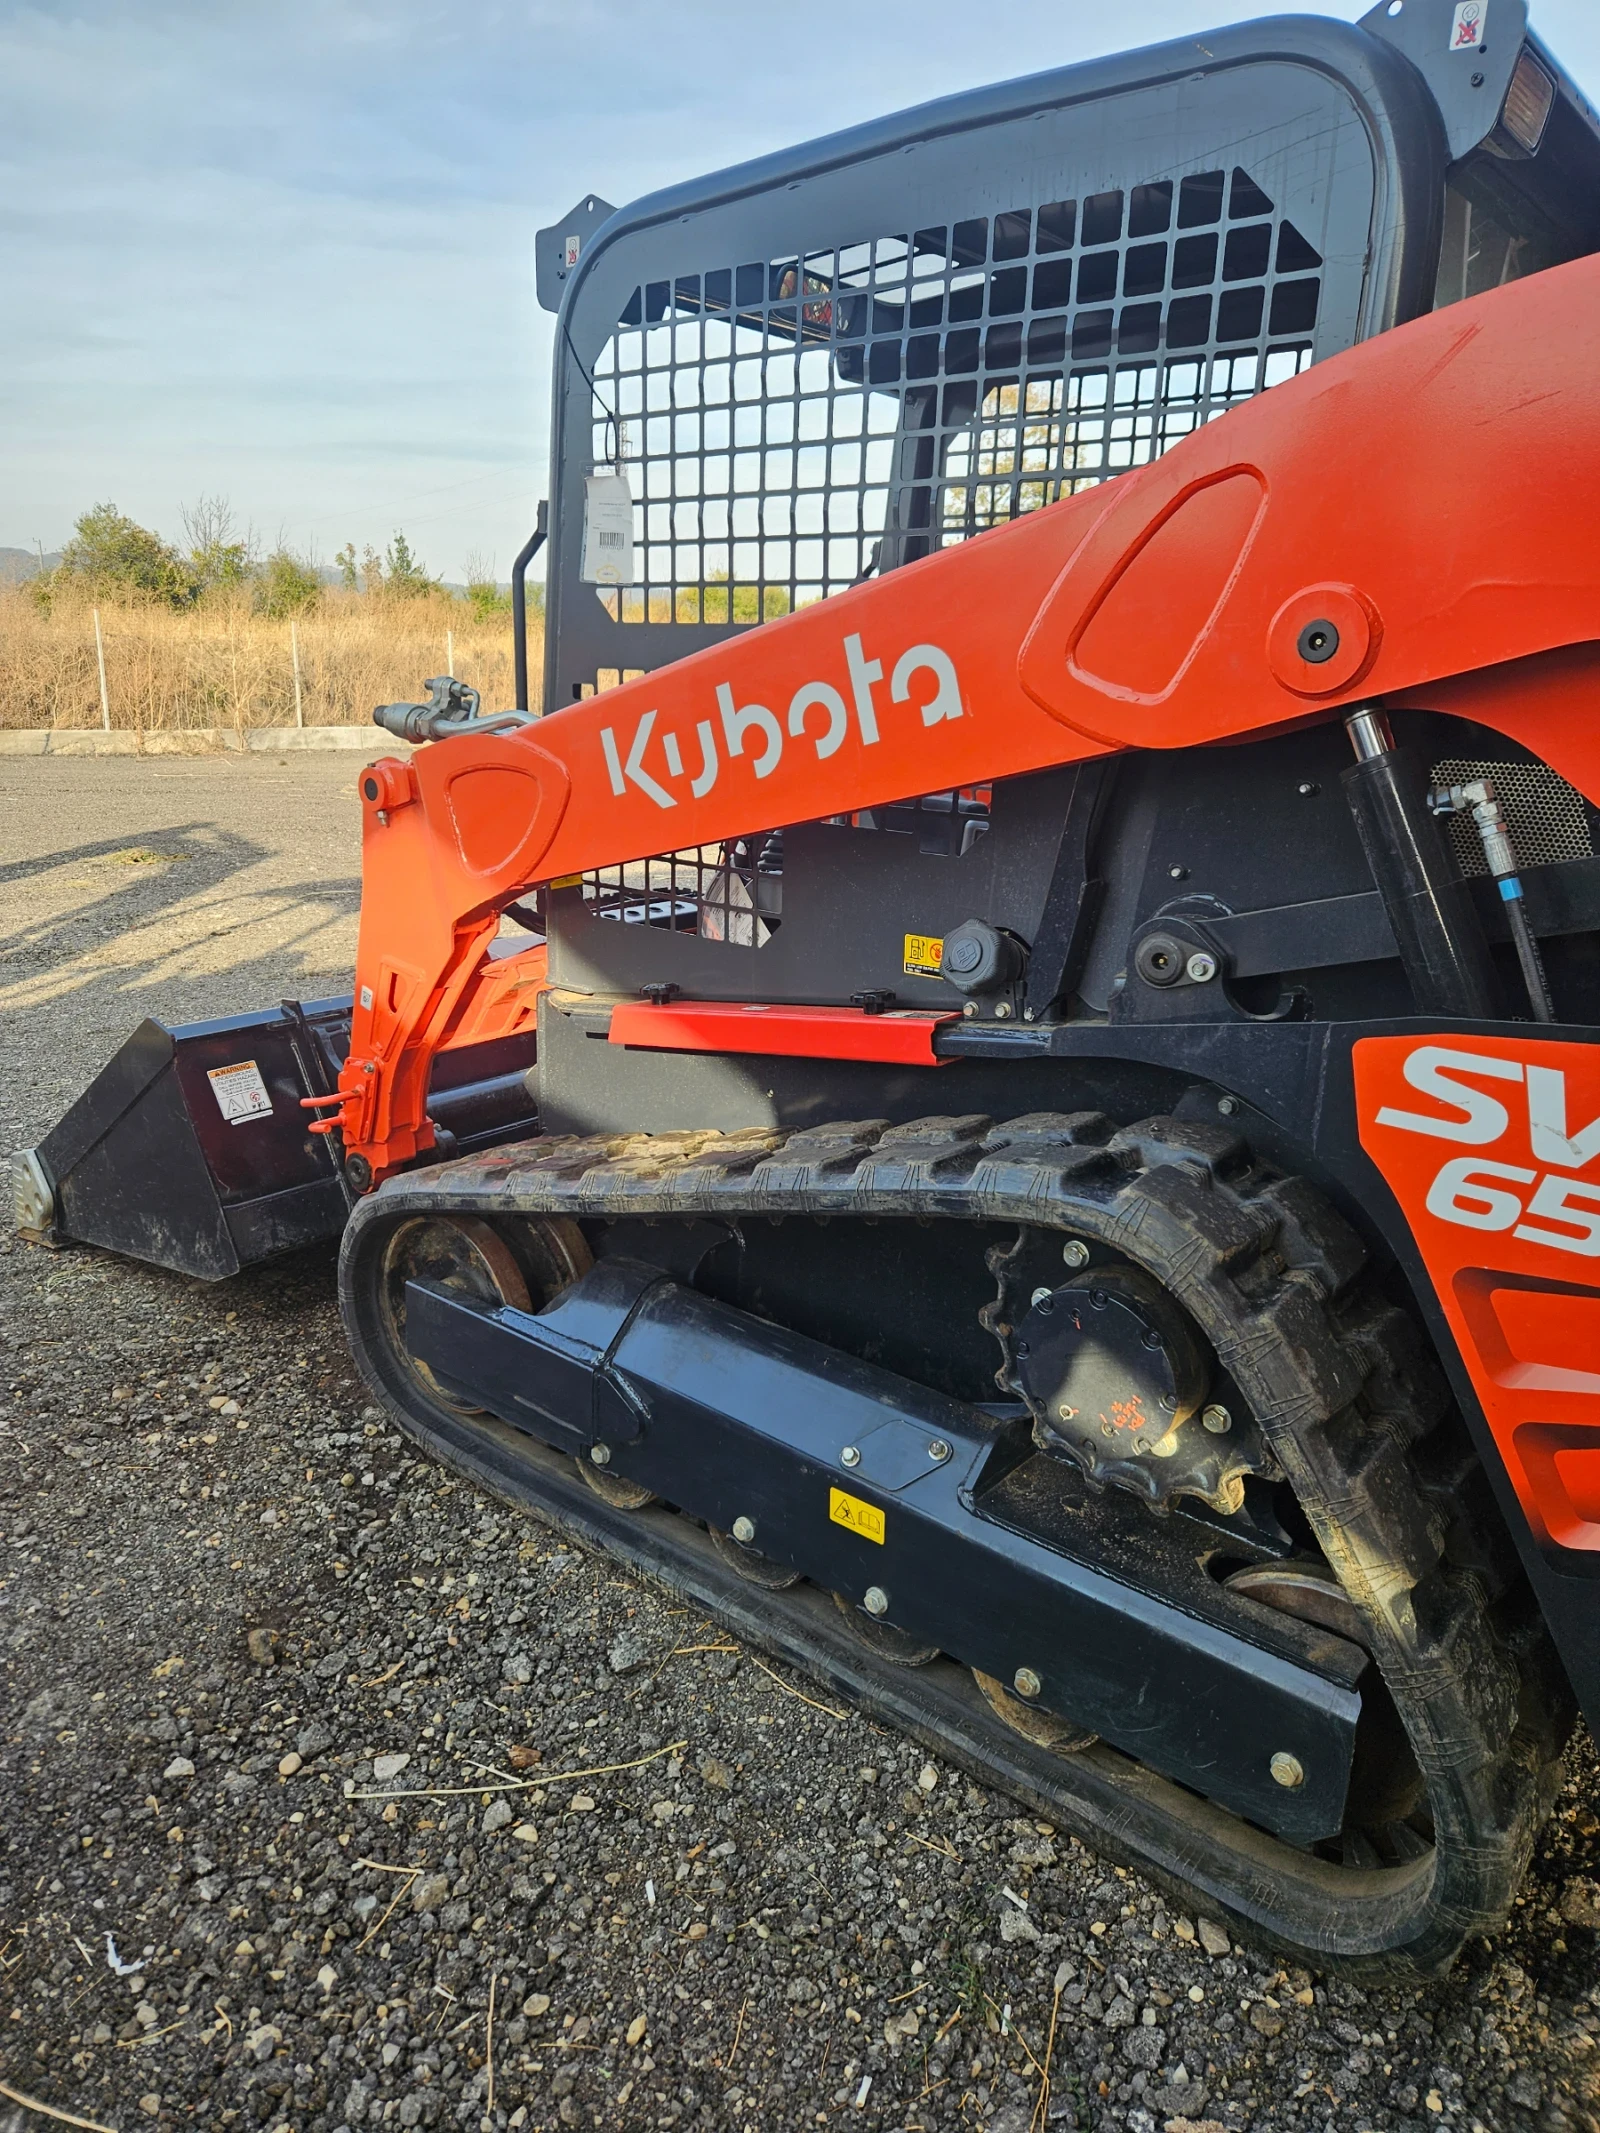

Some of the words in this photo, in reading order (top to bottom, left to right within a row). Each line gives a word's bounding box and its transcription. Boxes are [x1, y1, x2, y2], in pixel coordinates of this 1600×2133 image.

[600, 632, 964, 809] Kubota
[220, 1063, 250, 1075] WARNING
[1425, 1157, 1600, 1257] 65
